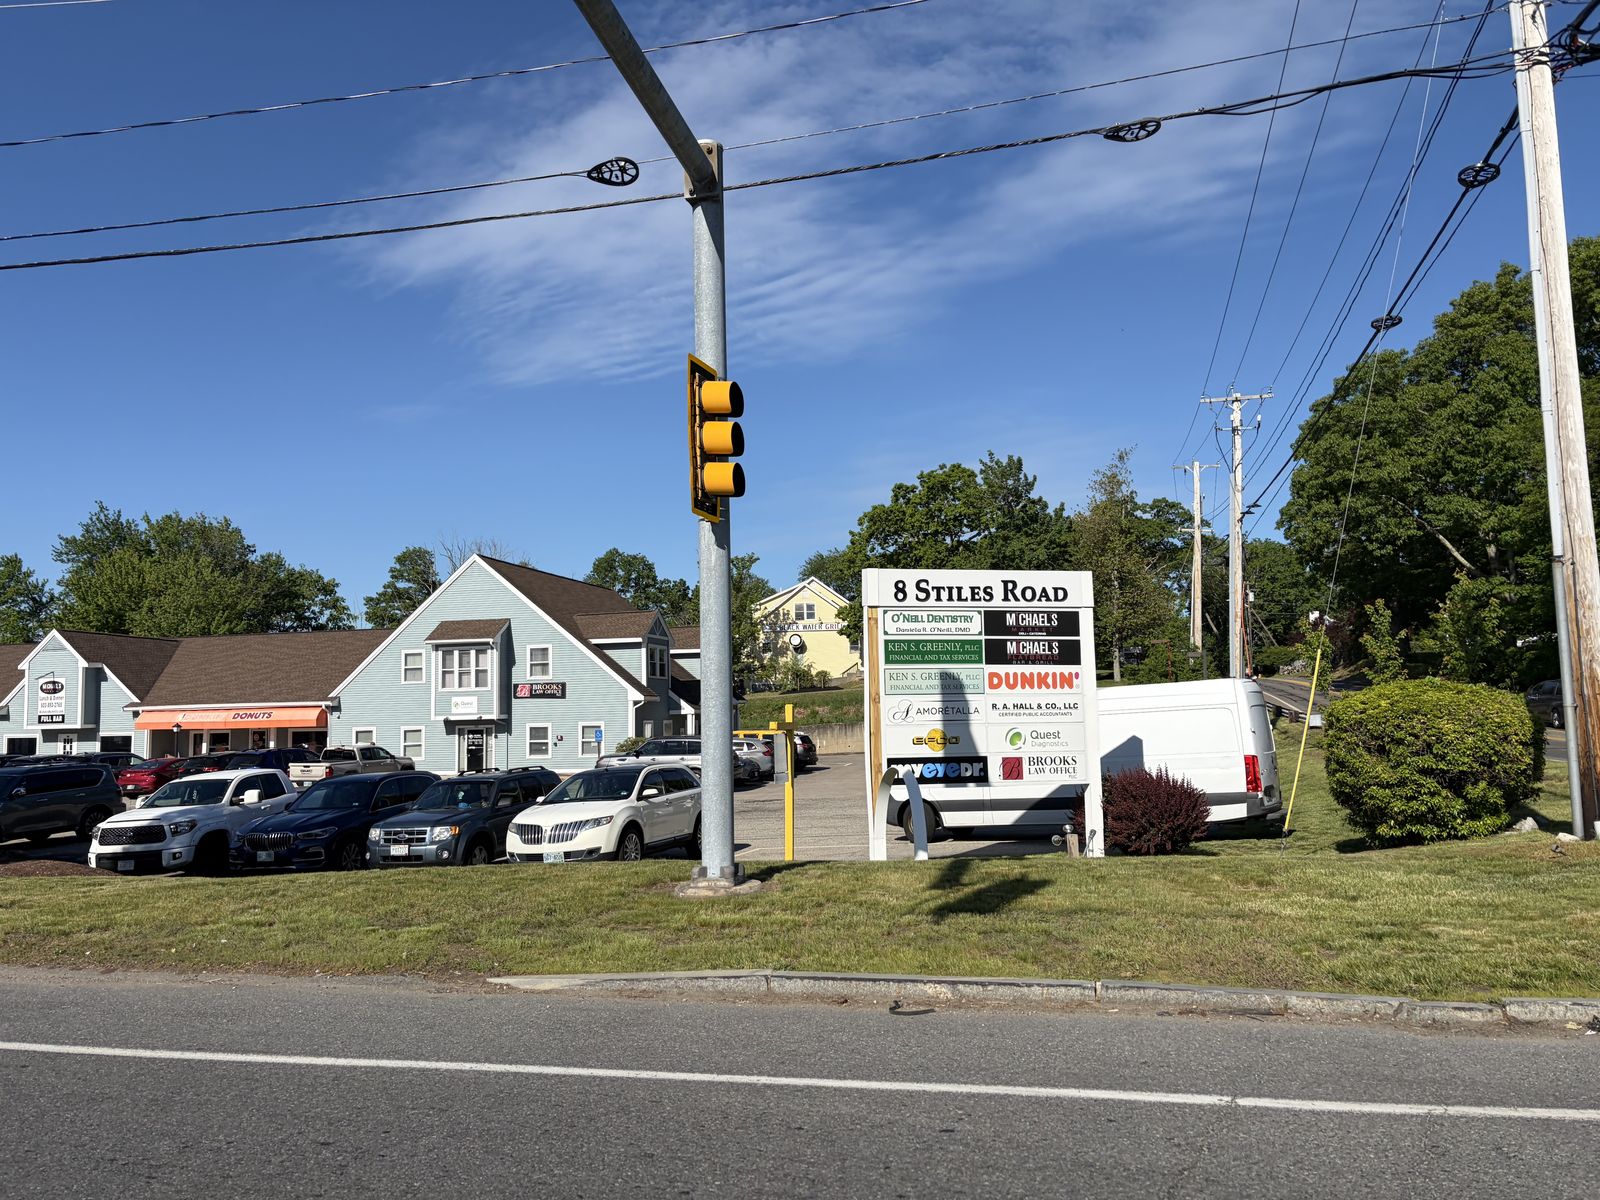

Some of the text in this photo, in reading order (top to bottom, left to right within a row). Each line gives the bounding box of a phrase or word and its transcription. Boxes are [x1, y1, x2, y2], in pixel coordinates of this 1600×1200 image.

[894, 578, 1068, 602] 8 STILES ROAD
[891, 612, 974, 623] O'NEILL DENTISTRY
[888, 642, 908, 652] KEN
[910, 642, 918, 652] S.
[920, 642, 962, 652] GREENLY,
[889, 672, 908, 680] KEN
[911, 672, 918, 680] S.
[920, 672, 964, 680] GREENLY,
[988, 672, 1080, 690] DUNKIN'
[232, 712, 273, 720] DONUTS
[1030, 730, 1060, 740] Quest
[1028, 756, 1078, 766] BROOKS
[1028, 766, 1078, 775] LAW OFFICE
